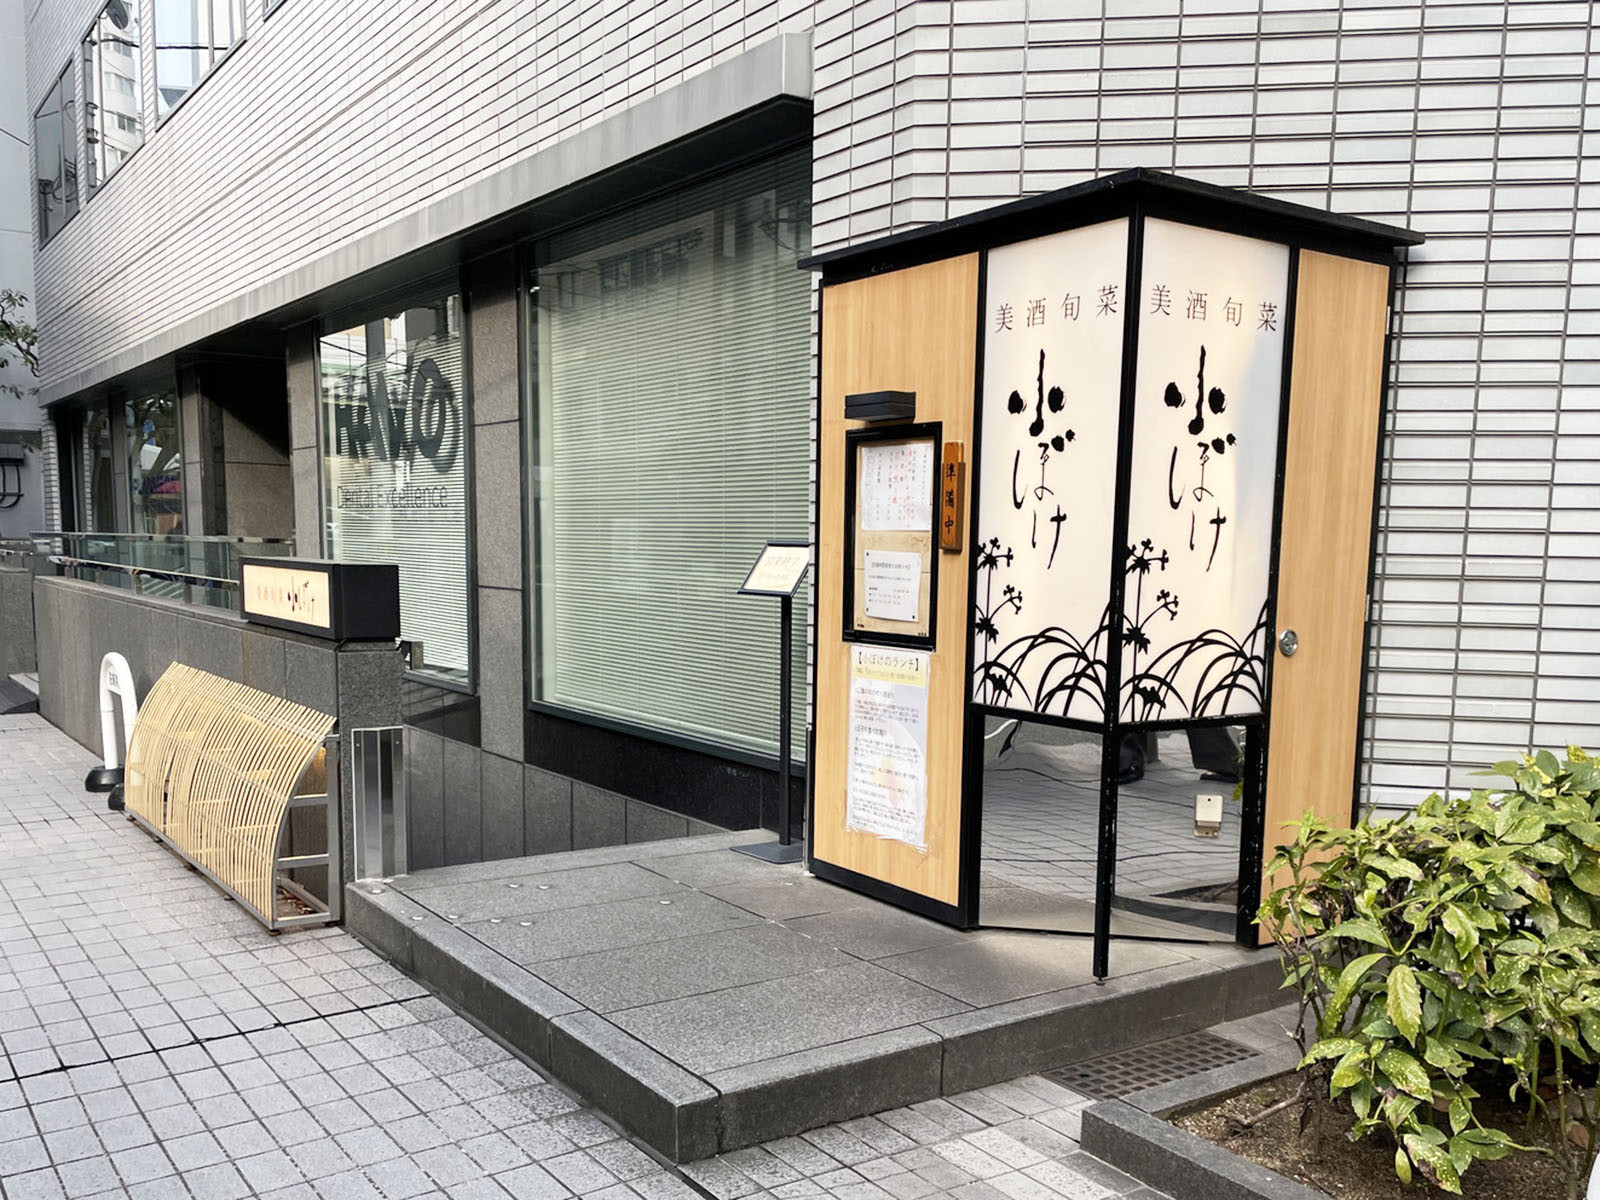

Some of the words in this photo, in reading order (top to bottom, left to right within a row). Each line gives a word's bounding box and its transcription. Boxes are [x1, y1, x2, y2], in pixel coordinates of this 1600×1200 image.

[995, 284, 1118, 333] 美酒旬菜
[1150, 284, 1278, 332] 美酒旬菜
